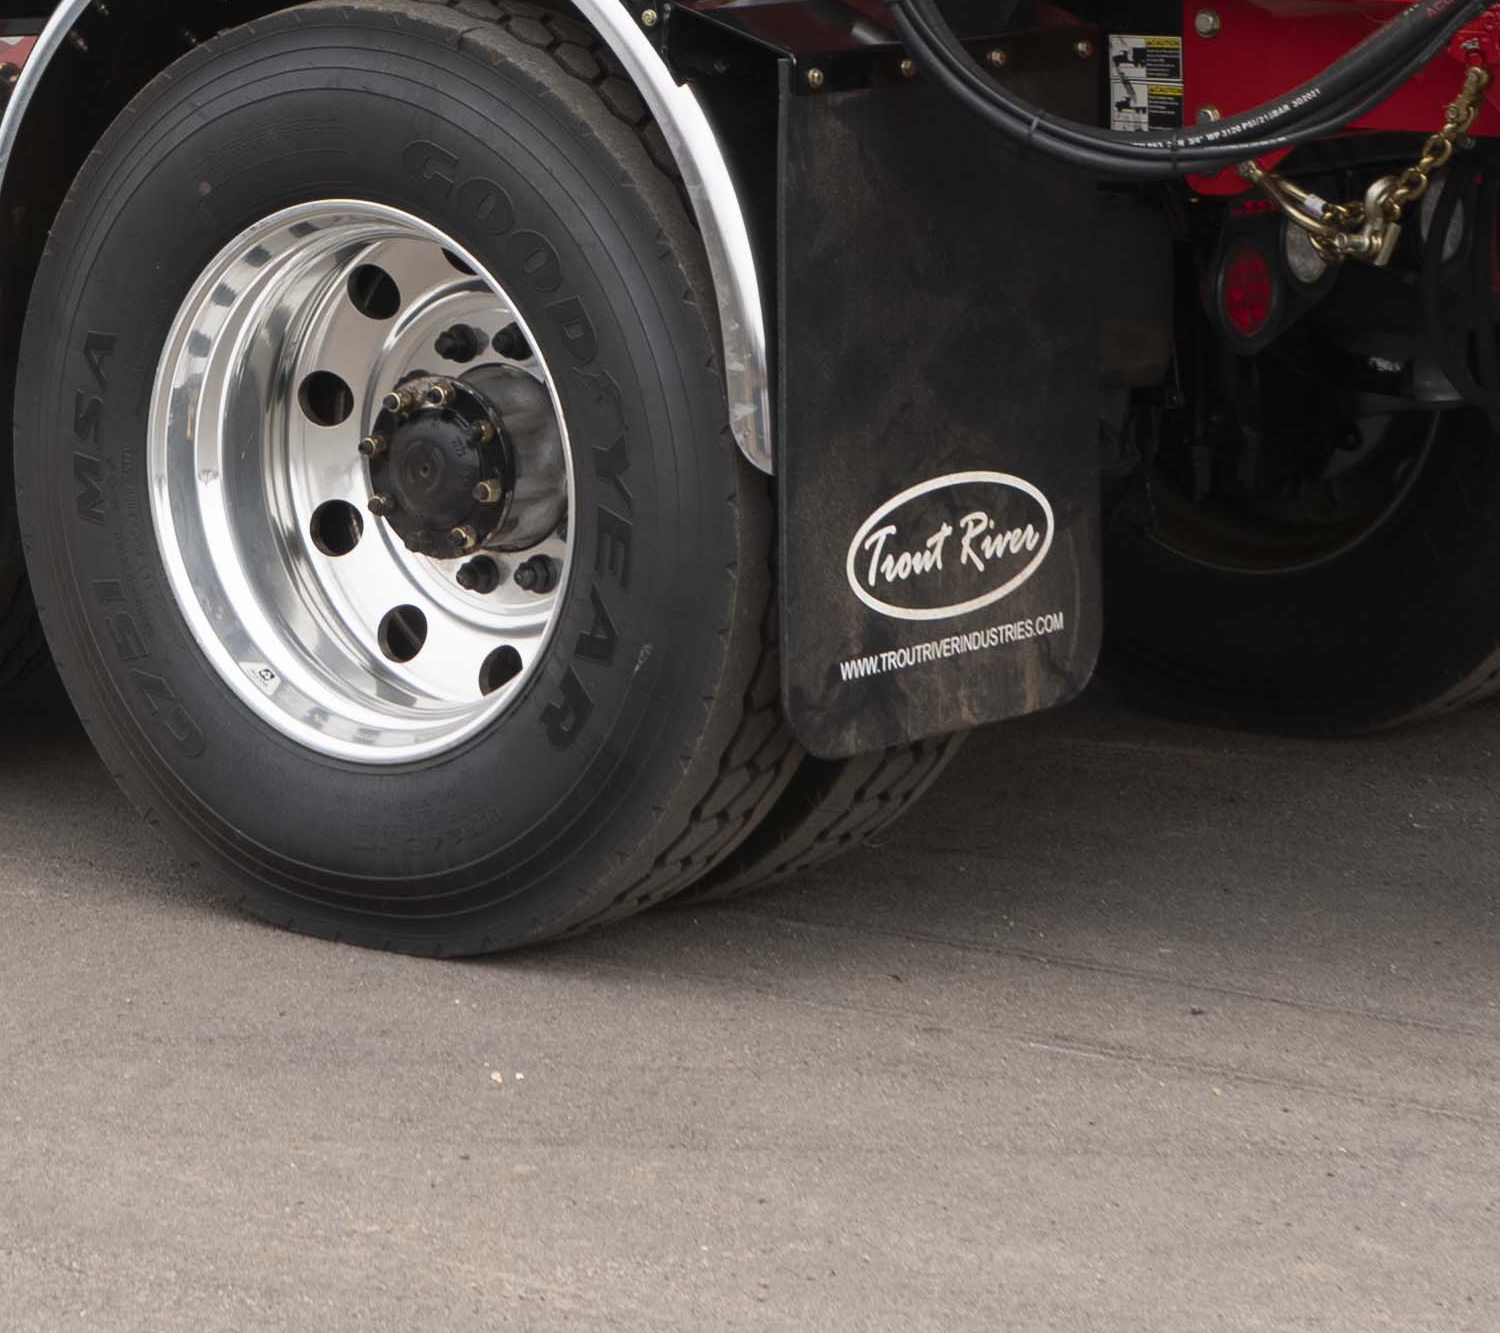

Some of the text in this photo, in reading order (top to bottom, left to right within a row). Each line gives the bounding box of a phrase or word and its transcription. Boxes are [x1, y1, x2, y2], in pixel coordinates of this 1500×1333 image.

[71, 331, 118, 526] MSA
[399, 138, 634, 753] GOODYEAR
[864, 510, 1041, 588] Trout River
[92, 577, 208, 759] G751
[838, 610, 1066, 683] WWW.TROUTRIVERINDUSTRIES.COM
